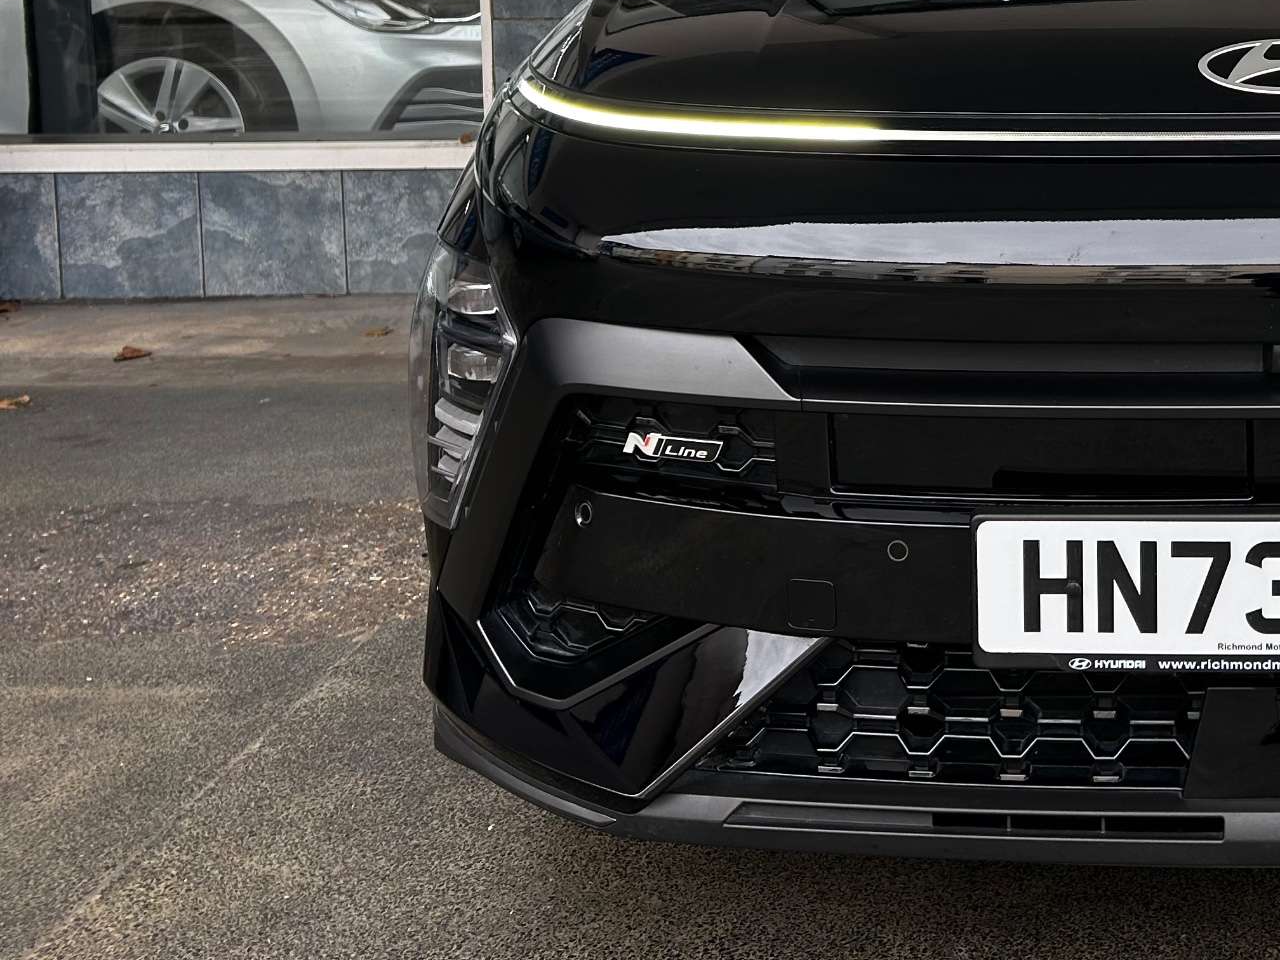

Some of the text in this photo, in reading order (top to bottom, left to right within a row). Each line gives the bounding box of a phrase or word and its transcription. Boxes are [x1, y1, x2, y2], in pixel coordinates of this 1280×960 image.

[665, 444, 708, 458] Line
[1217, 642, 1263, 651] Richmond
[1094, 659, 1146, 669] HYUNDAI
